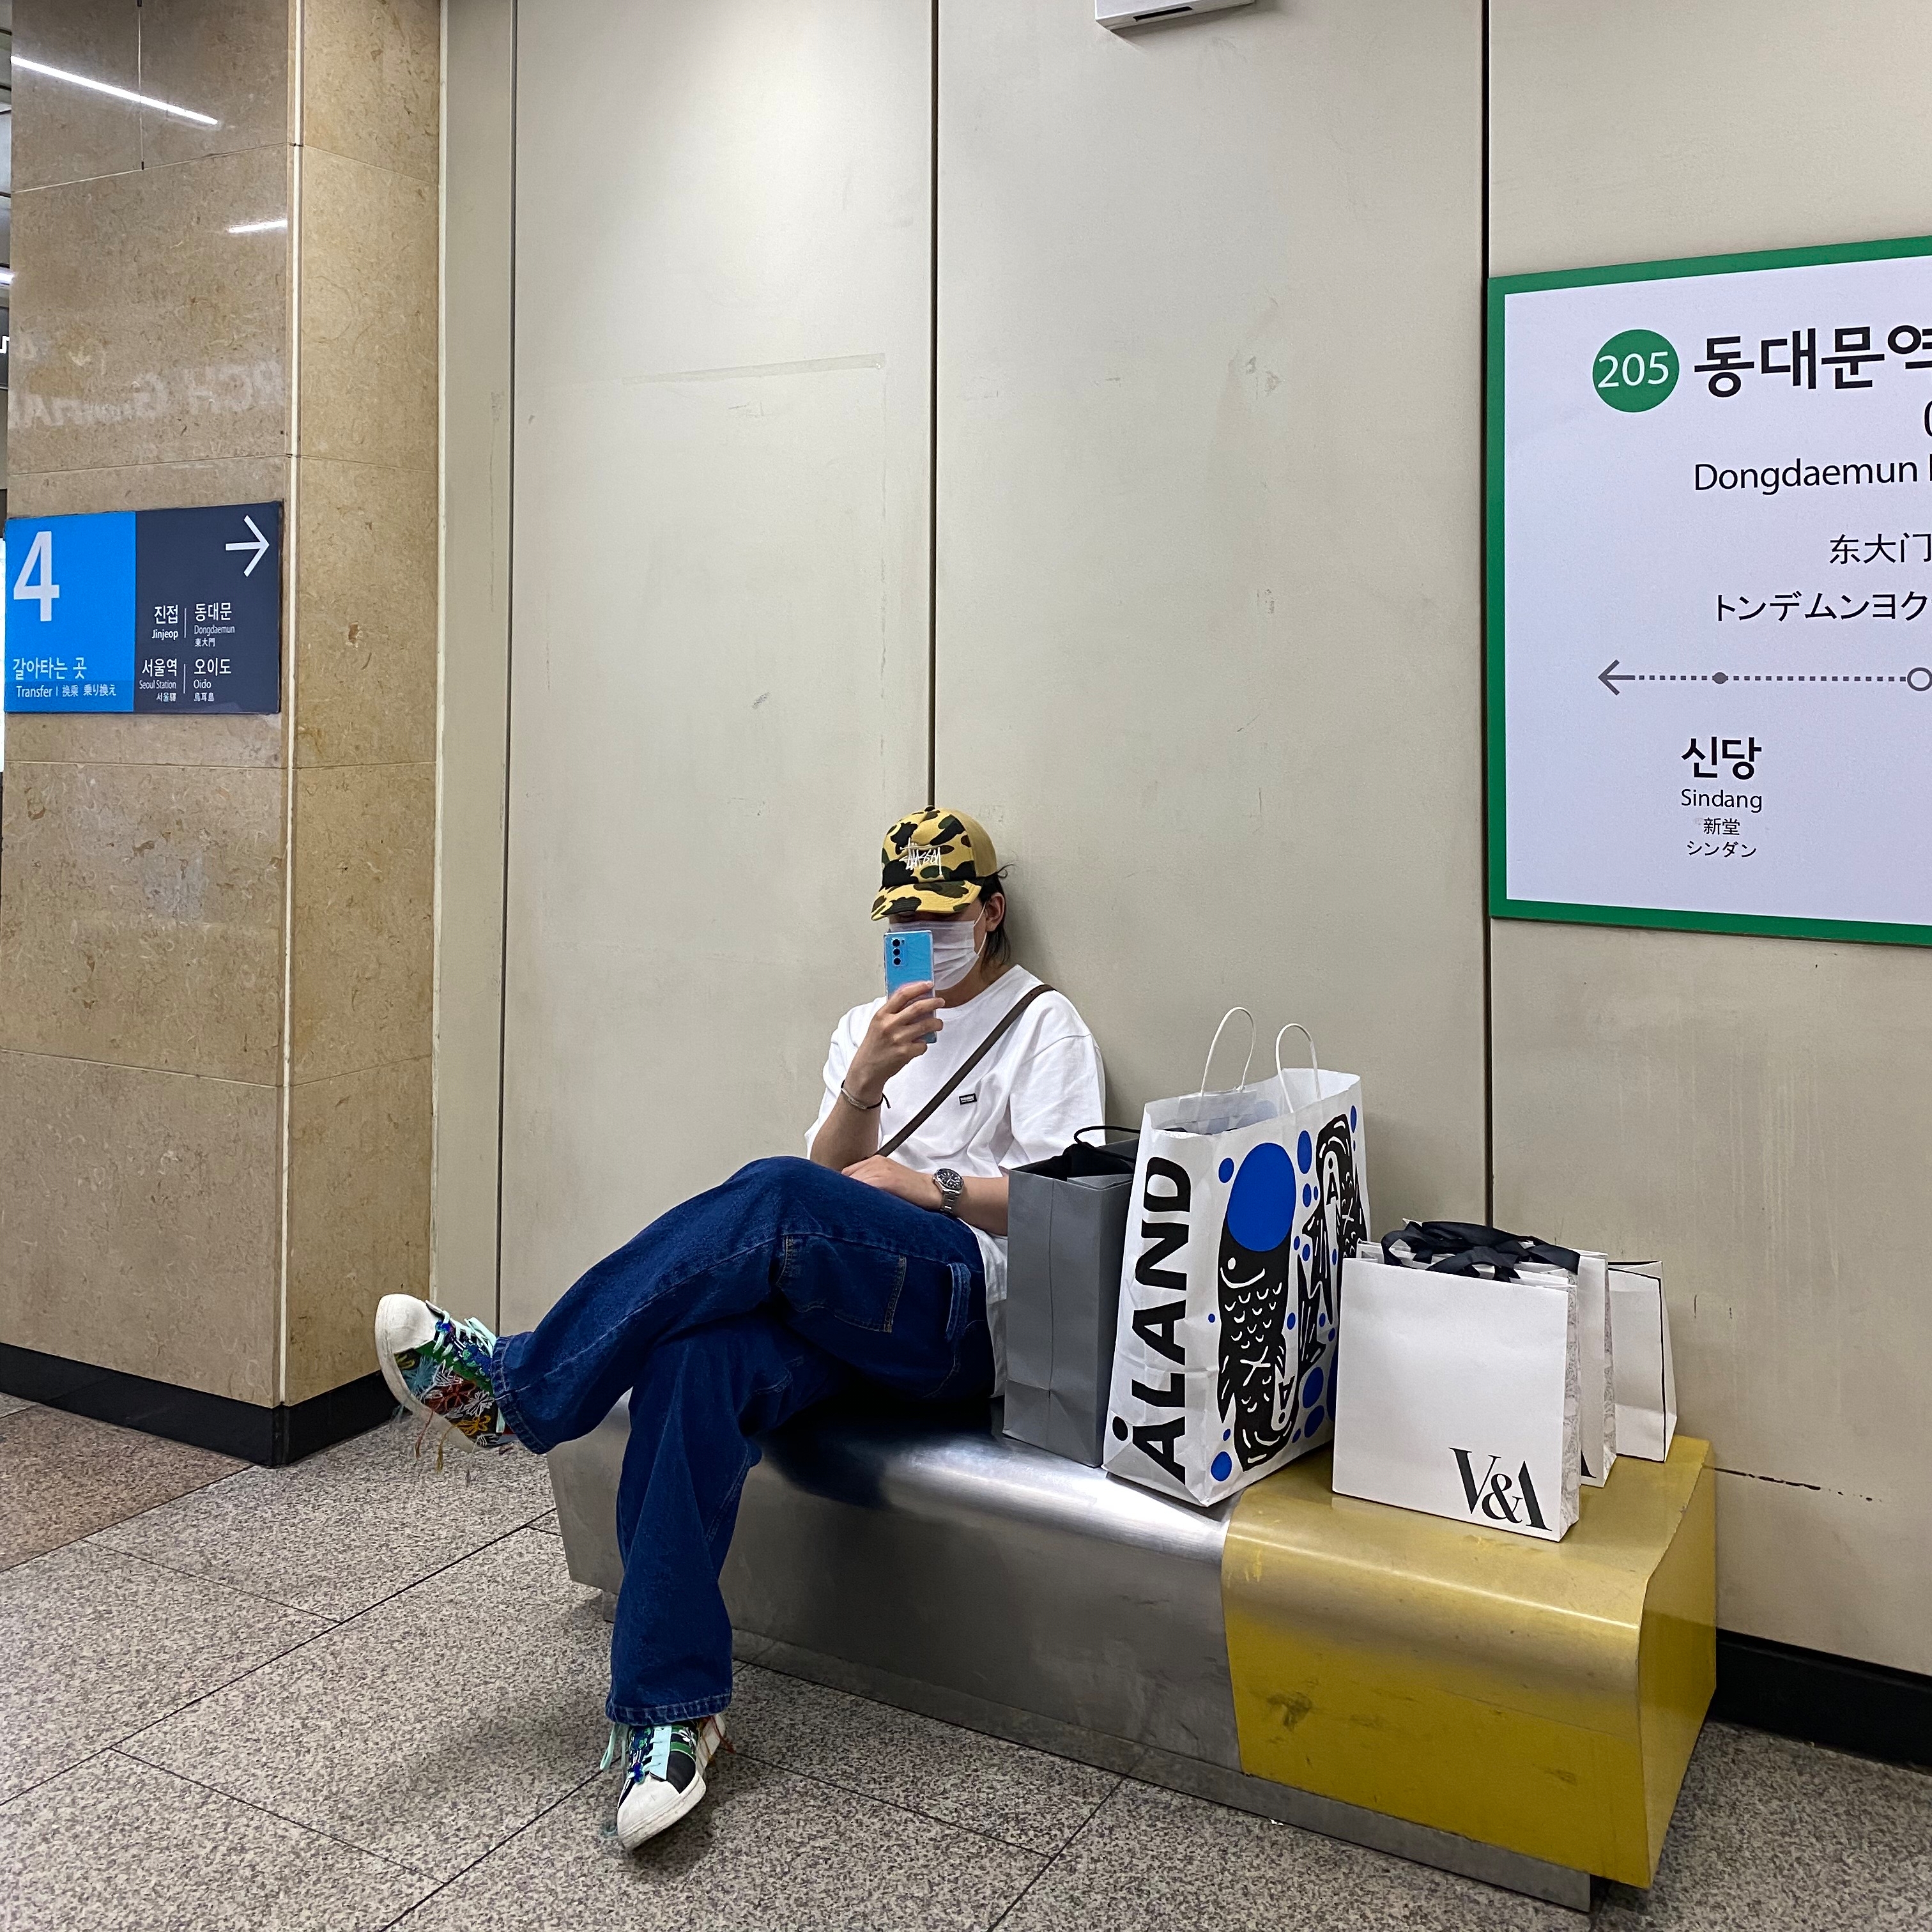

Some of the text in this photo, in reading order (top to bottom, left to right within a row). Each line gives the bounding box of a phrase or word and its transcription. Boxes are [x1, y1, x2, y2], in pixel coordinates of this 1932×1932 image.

[1597, 351, 1669, 389] 205
[1694, 457, 1917, 496] Dongdaemun
[1829, 532, 1932, 565] 东大门
[13, 531, 60, 622] 4
[154, 604, 178, 624] 진접
[194, 602, 233, 622] 동대문
[1717, 590, 1928, 622] トンデムンヨク
[151, 629, 179, 641] Jinjeop
[194, 624, 235, 636] Dongdaemun
[194, 637, 215, 648] 東大門
[12, 657, 88, 680] 갈아타는 곳
[141, 658, 177, 677] 서울역
[194, 657, 232, 677] 오이도
[16, 684, 53, 698] Transfer
[139, 679, 176, 689] Seoul Station
[193, 678, 211, 689] Oido
[1681, 736, 1762, 780] 신당
[1681, 788, 1763, 813] Sindang
[1703, 816, 1740, 836] 新堂
[1687, 840, 1757, 858] シンダン
[1448, 1447, 1552, 1531] V&A
